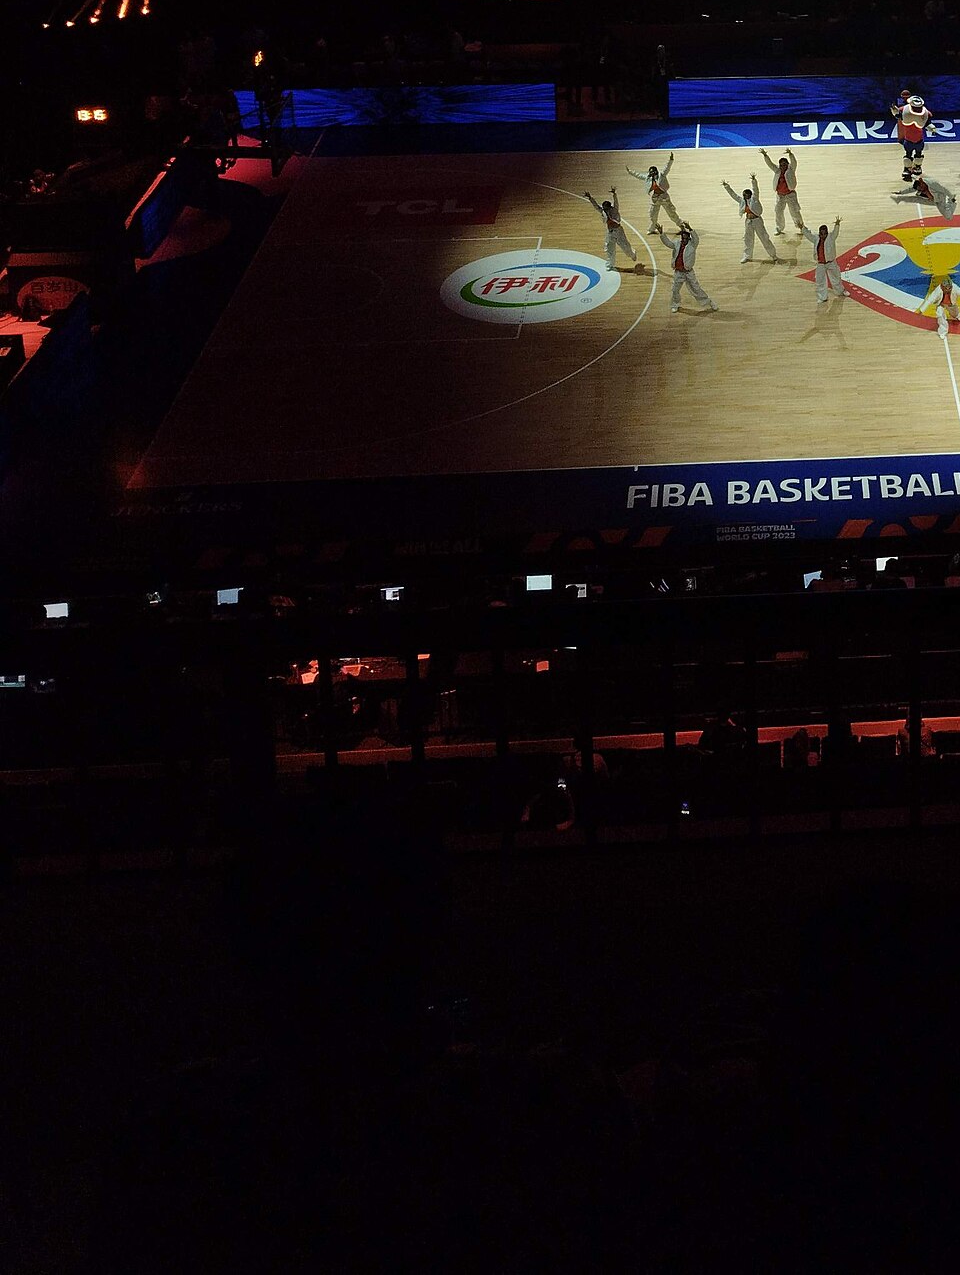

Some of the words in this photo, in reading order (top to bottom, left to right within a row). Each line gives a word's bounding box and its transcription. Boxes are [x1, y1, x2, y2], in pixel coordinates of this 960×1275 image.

[356, 199, 474, 215] TCL
[480, 275, 581, 295] 伊利
[627, 482, 714, 509] FIBA
[716, 526, 737, 534] FIBA
[738, 524, 796, 533] BASKETBALL
[716, 534, 750, 542] WORLD
